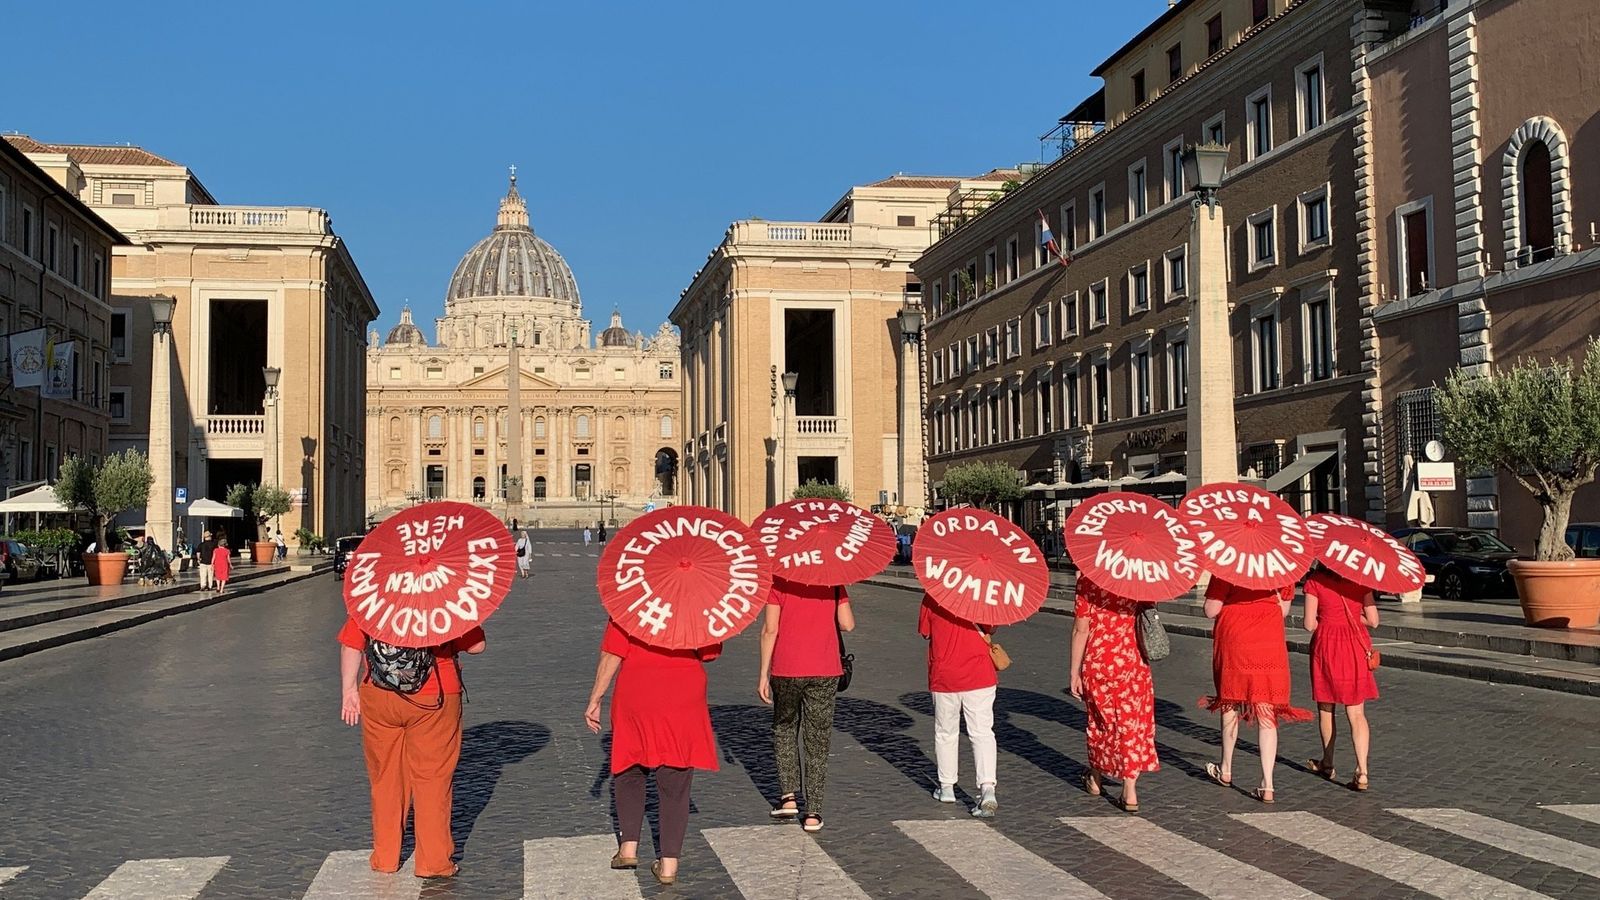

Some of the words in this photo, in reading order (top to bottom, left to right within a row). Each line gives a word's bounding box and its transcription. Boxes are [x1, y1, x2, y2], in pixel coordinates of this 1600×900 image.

[178, 489, 185, 497] P
[1186, 489, 1270, 516] SEXISM
[396, 515, 465, 542] HERE
[760, 517, 784, 557] MORE
[790, 501, 863, 517] THAN
[785, 513, 840, 540] HALF
[1213, 507, 1238, 521] IS
[1248, 507, 1263, 522] A
[1276, 514, 1305, 554] SIN
[404, 533, 447, 556] ARE
[780, 550, 823, 568] THE
[835, 515, 875, 562] CHURCH
[933, 516, 1037, 563] ORDAIN
[1075, 499, 1147, 536] REFORM
[1154, 509, 1198, 580] MEANS
[1322, 515, 1422, 584] REIGNING
[384, 564, 457, 594] WOMEN
[925, 556, 1025, 607] WOMEN
[1095, 540, 1170, 583] WOMEN
[1325, 540, 1386, 582] MEN
